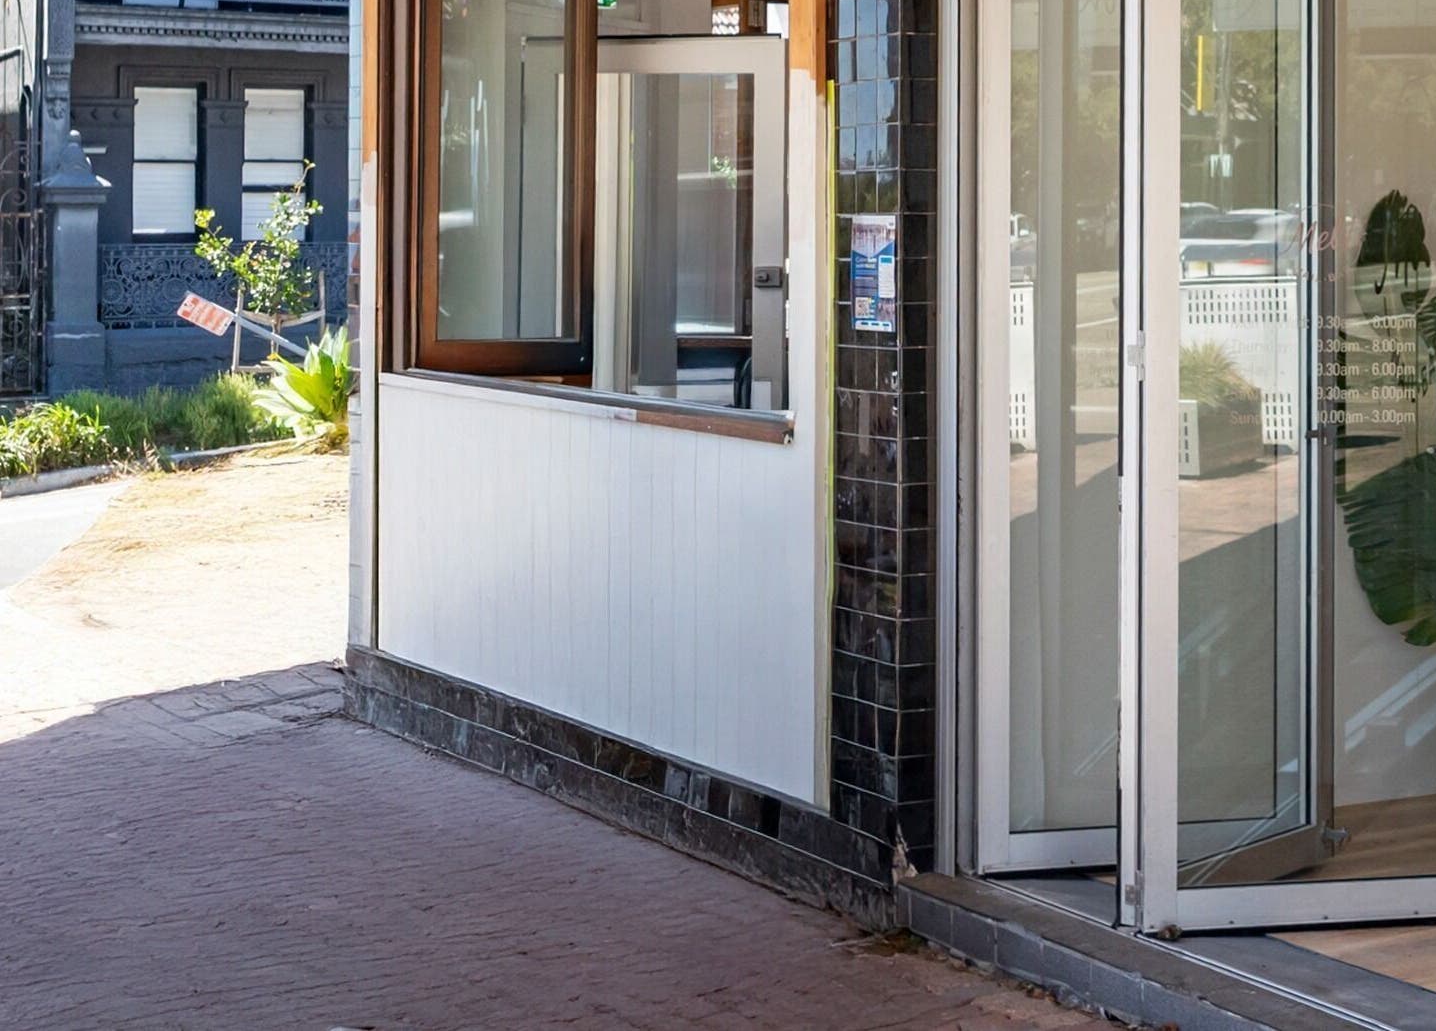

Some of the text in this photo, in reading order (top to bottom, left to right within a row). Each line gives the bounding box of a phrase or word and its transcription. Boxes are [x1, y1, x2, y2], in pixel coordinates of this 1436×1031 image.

[1371, 338, 1416, 355] 8.00pm
[1371, 361, 1416, 378] 6.00pm
[1371, 409, 1416, 426] 3.00pm
